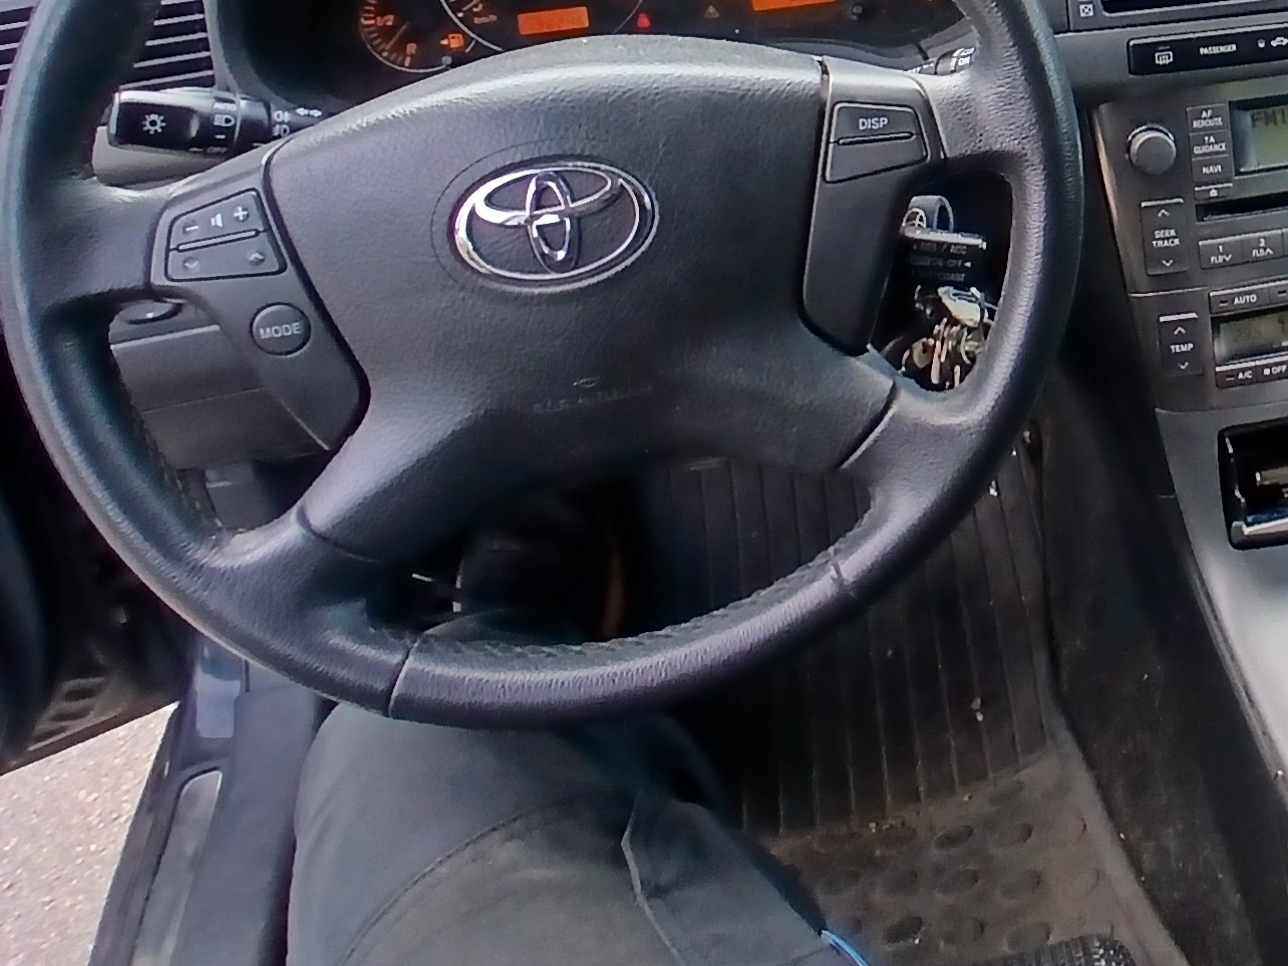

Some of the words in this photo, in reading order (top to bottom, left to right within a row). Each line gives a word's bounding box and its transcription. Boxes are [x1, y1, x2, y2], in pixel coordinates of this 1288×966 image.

[1199, 44, 1237, 55] PASSENGER
[858, 117, 888, 130] DISP
[1193, 142, 1227, 155] GUIDANCE
[1202, 164, 1222, 174] NAVI
[1152, 238, 1180, 248] TRACK
[1233, 293, 1257, 305] AUTO
[259, 322, 302, 339] MODE
[1170, 343, 1194, 353] TEMP
[1271, 365, 1287, 375] OFF
[1238, 371, 1252, 380] A/C
